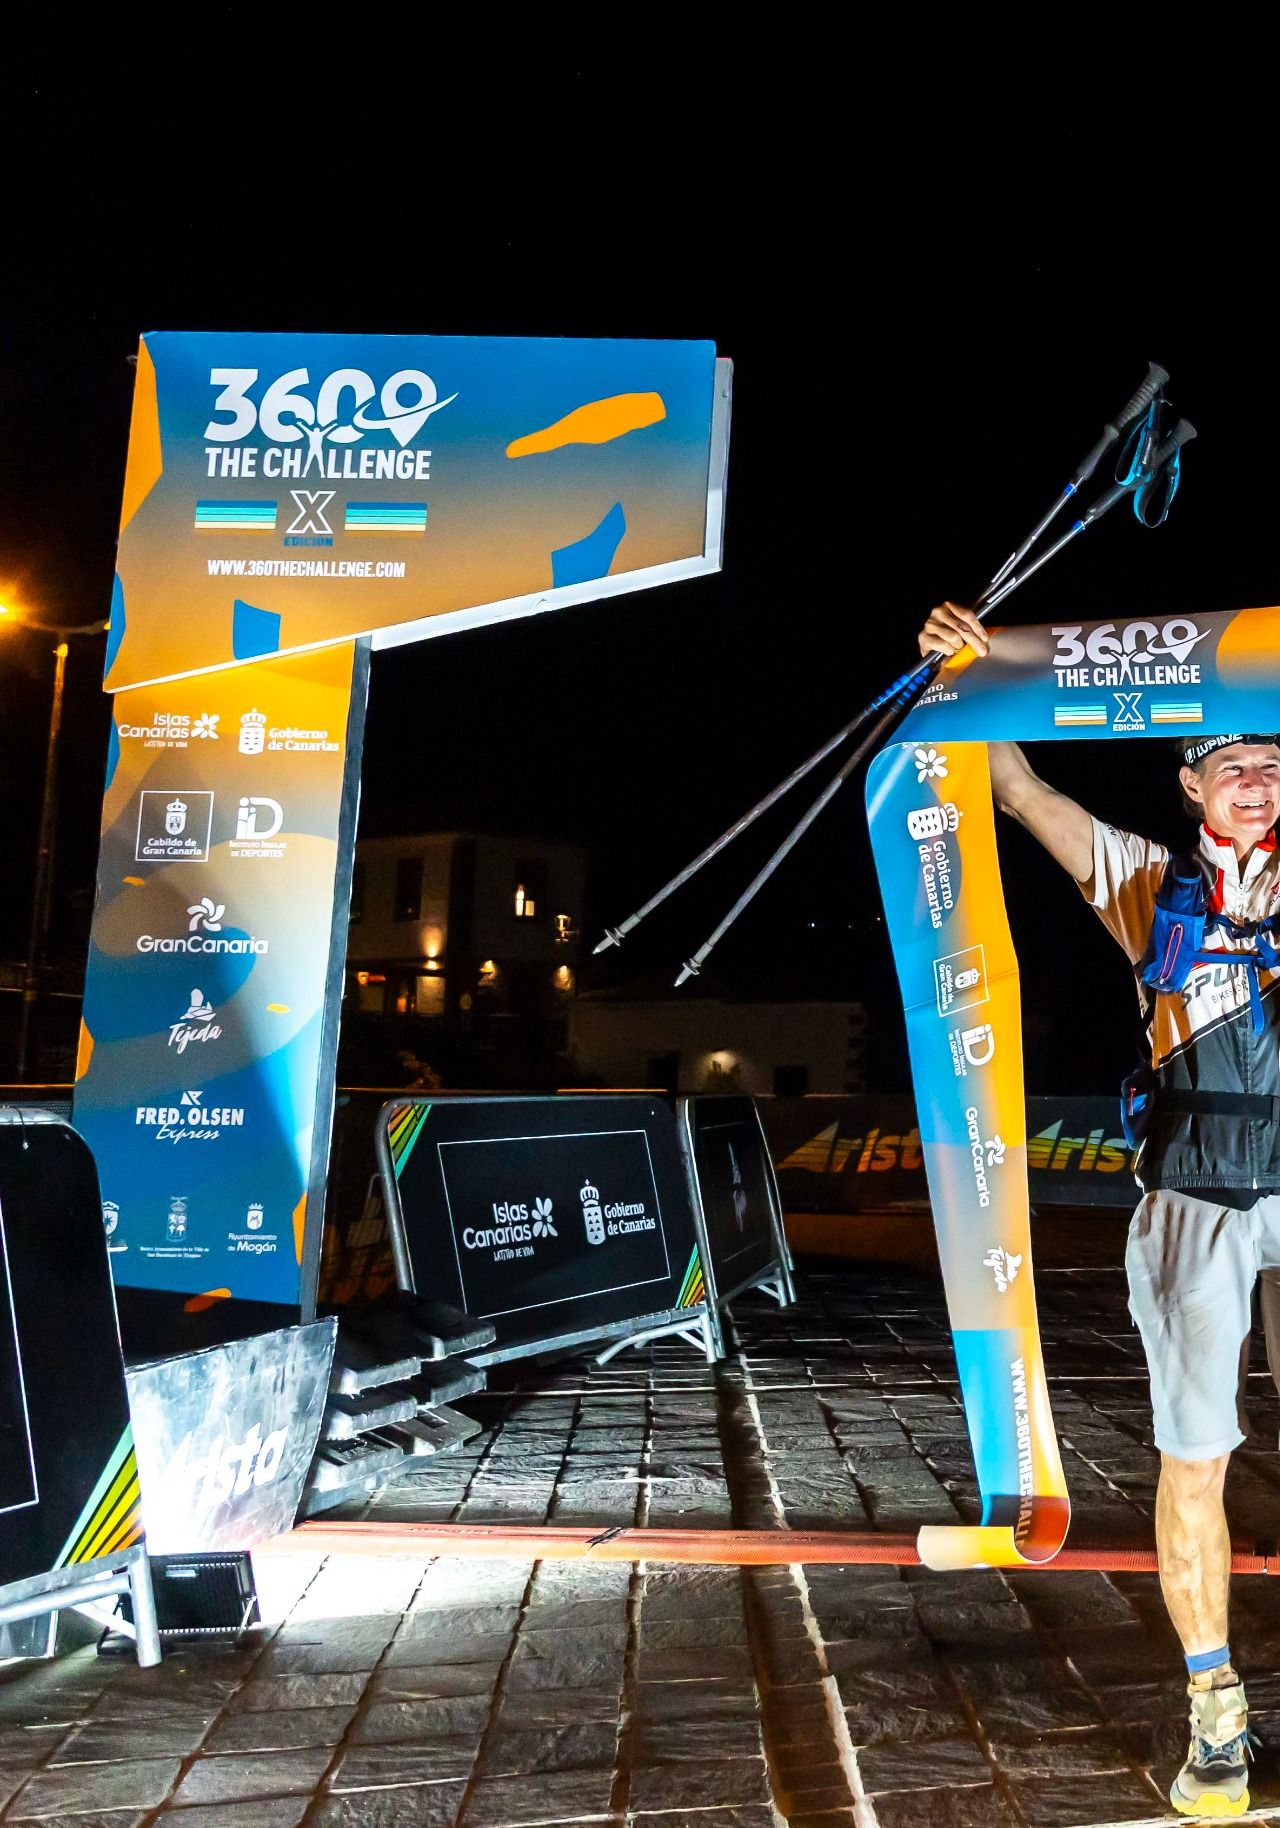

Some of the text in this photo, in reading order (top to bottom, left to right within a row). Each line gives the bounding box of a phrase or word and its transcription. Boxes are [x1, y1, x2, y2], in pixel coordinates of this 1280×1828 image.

[205, 447, 256, 478] THE
[286, 490, 336, 534] X
[207, 559, 405, 578] WWW.360THECHALLENGE.COM
[1054, 668, 1090, 688] THE
[1112, 692, 1144, 723] X
[153, 712, 191, 726] Islas
[118, 724, 189, 739] Canarias
[269, 727, 328, 739] Gobierno
[268, 740, 339, 752] de Canarias
[1196, 733, 1244, 757] LUPINE
[143, 846, 202, 856] Gran Canaria
[184, 838, 197, 847] de
[933, 841, 954, 910] Gobierno
[918, 844, 942, 929] de Canarias
[136, 935, 268, 954] GranCanaria
[156, 1123, 220, 1144] Express
[965, 1106, 991, 1209] GranCanaria
[493, 1202, 528, 1224] Islas
[604, 1203, 644, 1218] Gobierno
[463, 1221, 532, 1249] Canarias
[607, 1217, 655, 1236] de Canarias
[237, 1240, 276, 1254] Mogán
